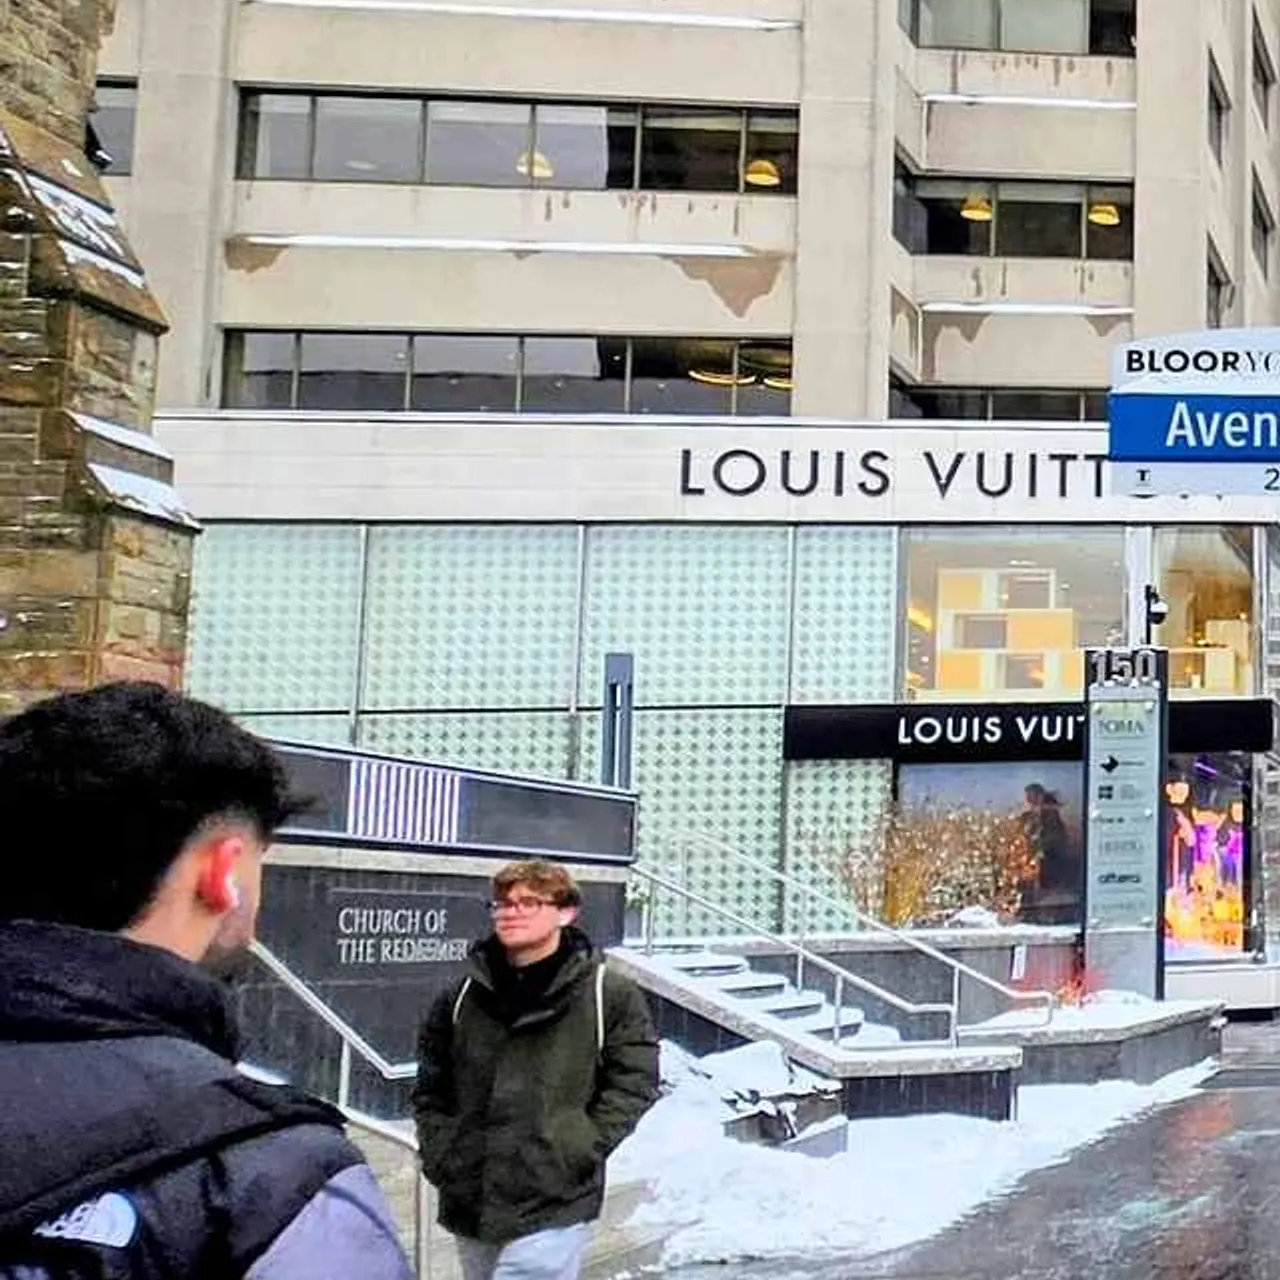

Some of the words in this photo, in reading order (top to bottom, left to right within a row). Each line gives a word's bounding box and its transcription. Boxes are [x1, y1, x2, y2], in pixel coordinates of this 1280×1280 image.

[681, 449, 890, 497] LOUIS
[1091, 650, 1157, 687] 150
[898, 717, 1002, 744] LOUIS
[1015, 716, 1085, 742] VUI
[338, 907, 421, 935] CHURCH
[424, 909, 449, 934] OF
[336, 938, 376, 964] THE
